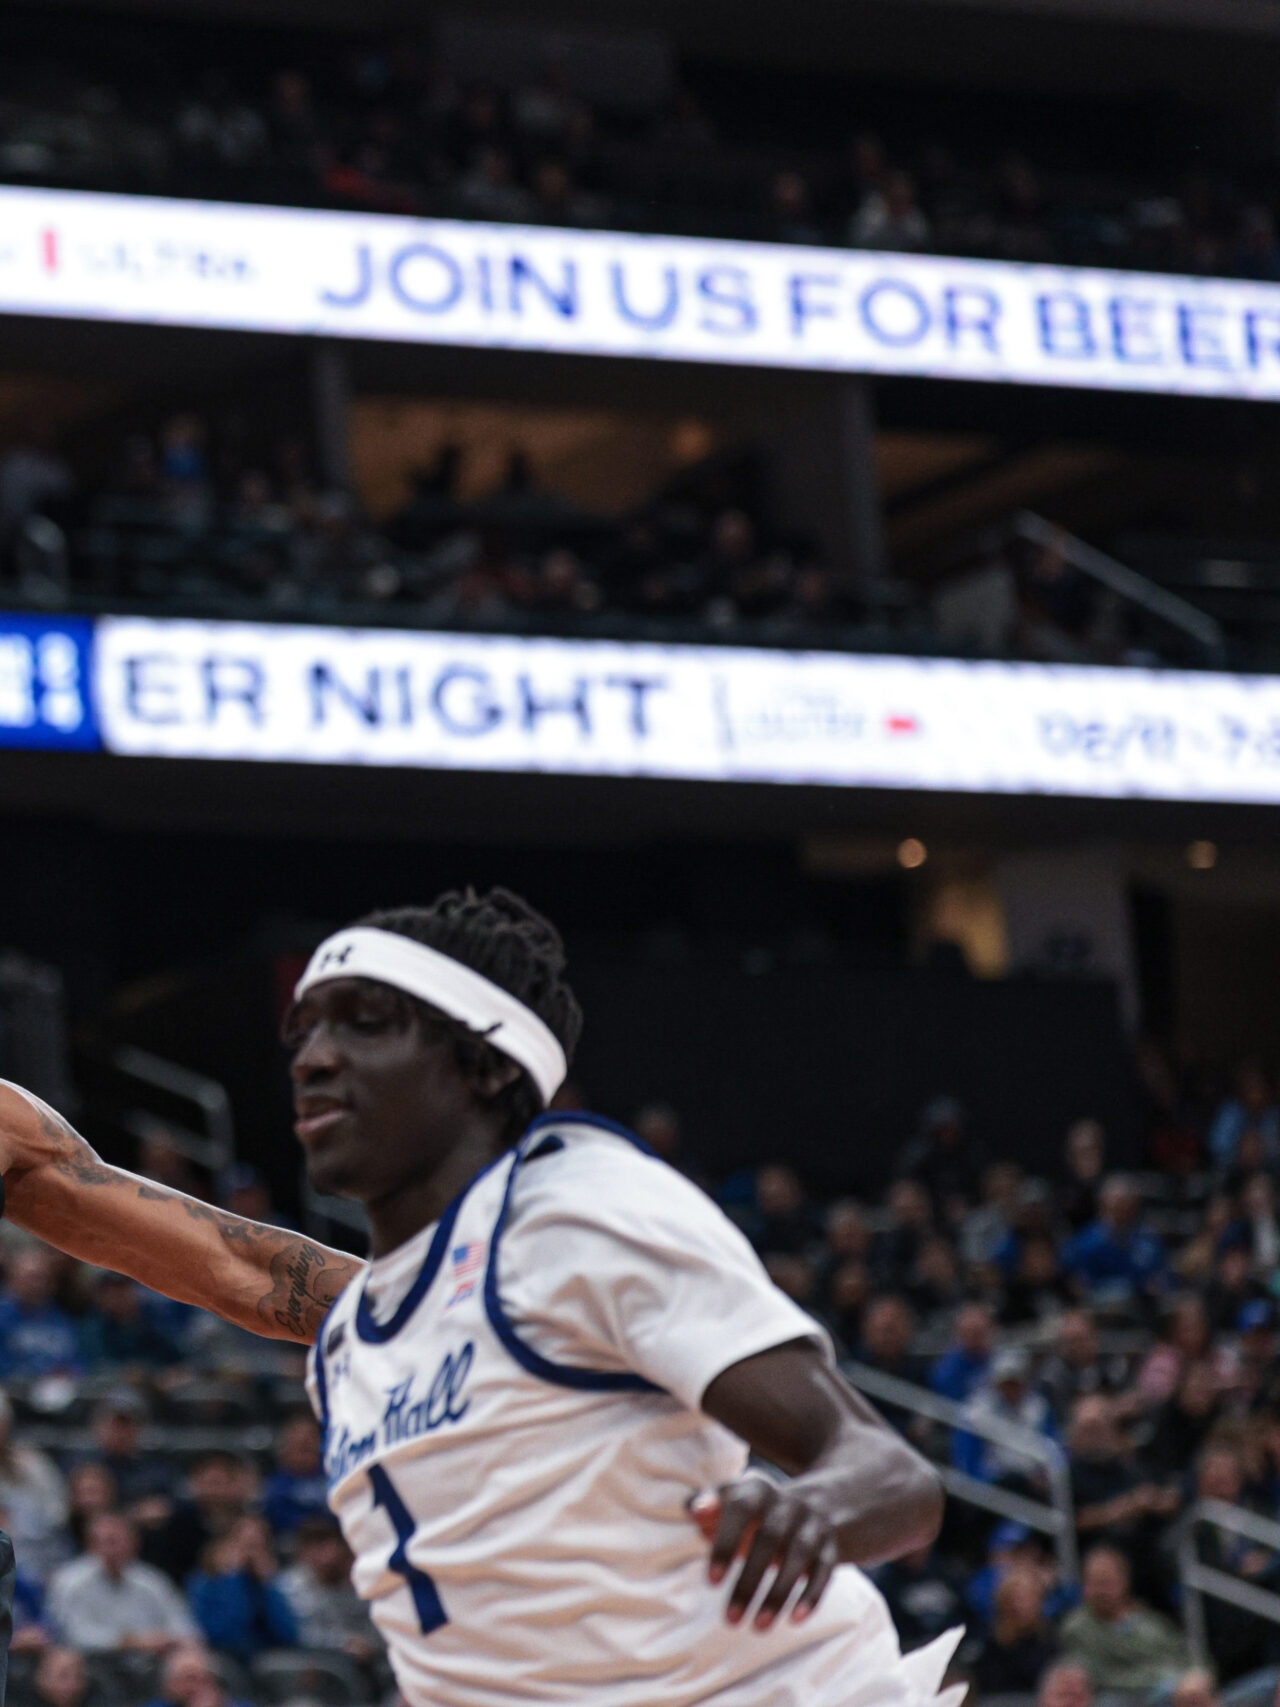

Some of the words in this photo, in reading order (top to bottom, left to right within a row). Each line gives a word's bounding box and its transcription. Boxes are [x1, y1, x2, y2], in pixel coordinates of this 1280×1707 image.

[320, 240, 578, 322] JOIN
[610, 259, 760, 338] US
[788, 270, 1002, 354] FOR
[1035, 292, 1280, 372] BEER
[122, 654, 266, 730] ER
[310, 662, 668, 738] NIGHT
[381, 1341, 475, 1446] Hall
[366, 1462, 450, 1635] 1
